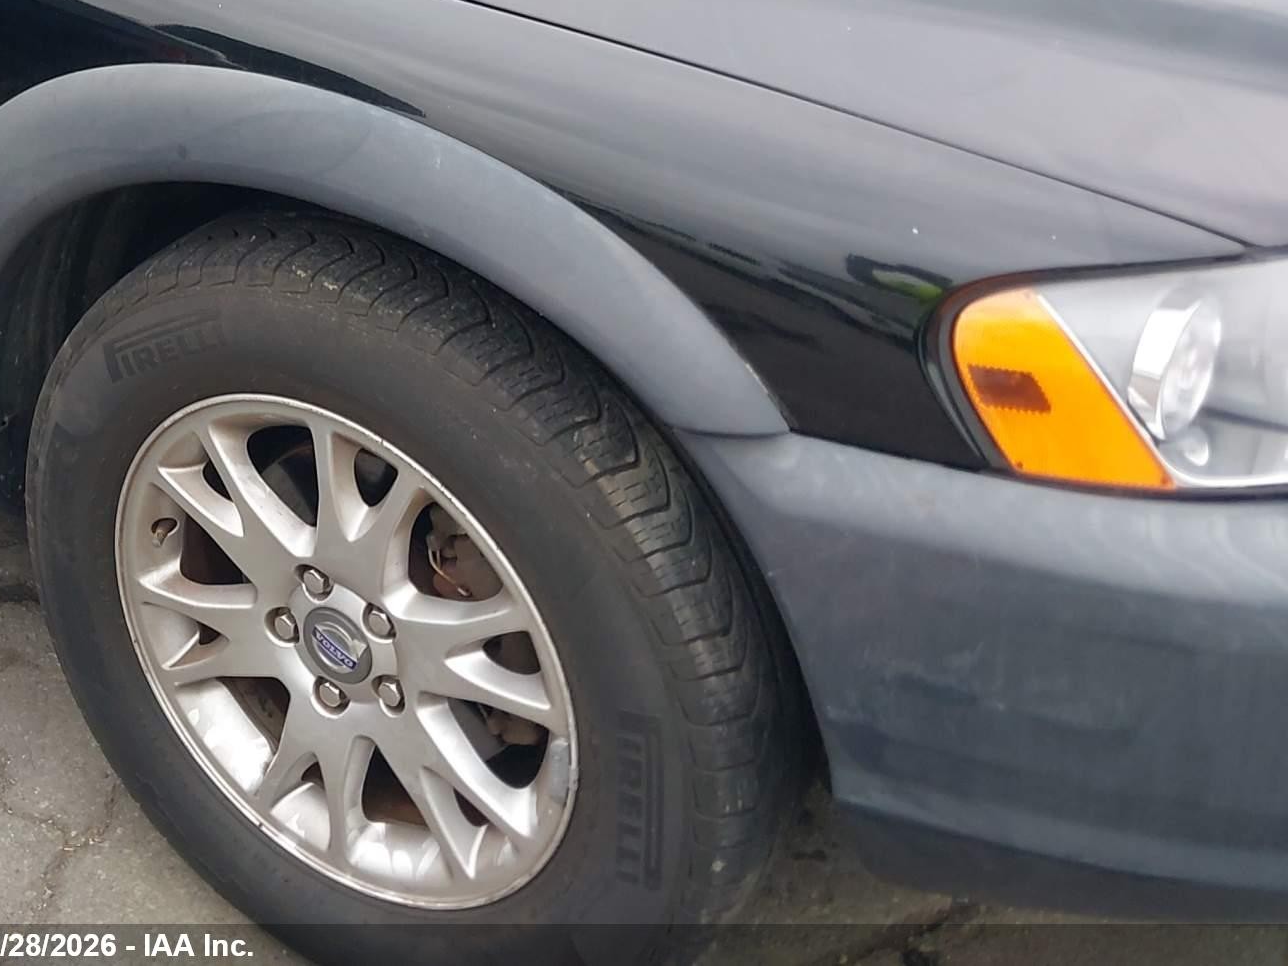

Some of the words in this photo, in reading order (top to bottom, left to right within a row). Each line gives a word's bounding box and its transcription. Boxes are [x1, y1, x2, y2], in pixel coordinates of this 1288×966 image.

[102, 308, 227, 383] PIRELLI
[314, 631, 354, 668] VOLVO
[615, 710, 664, 890] PIRELLI
